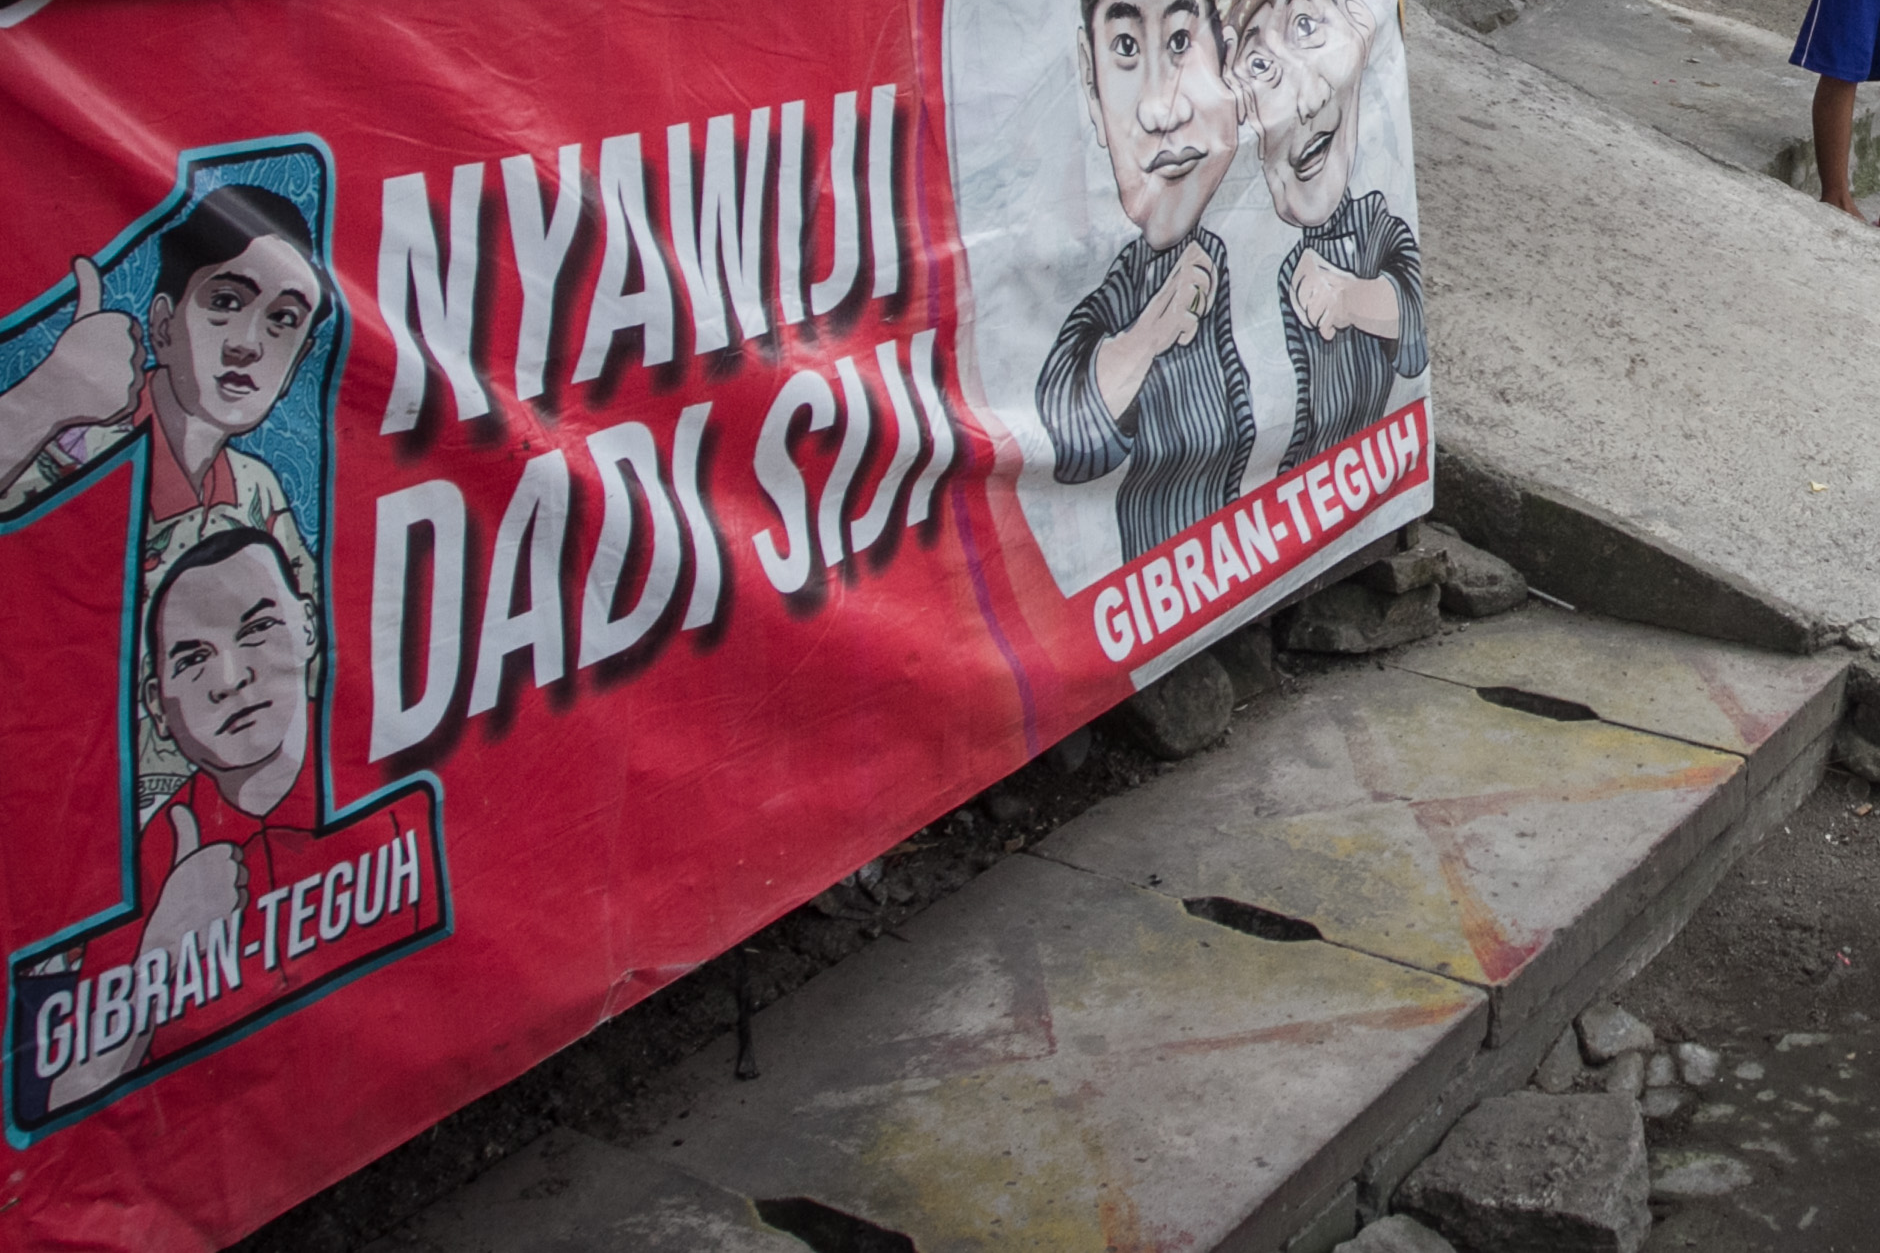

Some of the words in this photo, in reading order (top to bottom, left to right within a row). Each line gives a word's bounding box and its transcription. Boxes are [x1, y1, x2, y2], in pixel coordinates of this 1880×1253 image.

[377, 83, 900, 436] NYAWIJI
[369, 401, 722, 763] DADI
[752, 328, 954, 594] SIJI
[1094, 413, 1421, 662] GIBRAN-TEGUH
[36, 830, 421, 1079] GIBRAN-TEGUH
